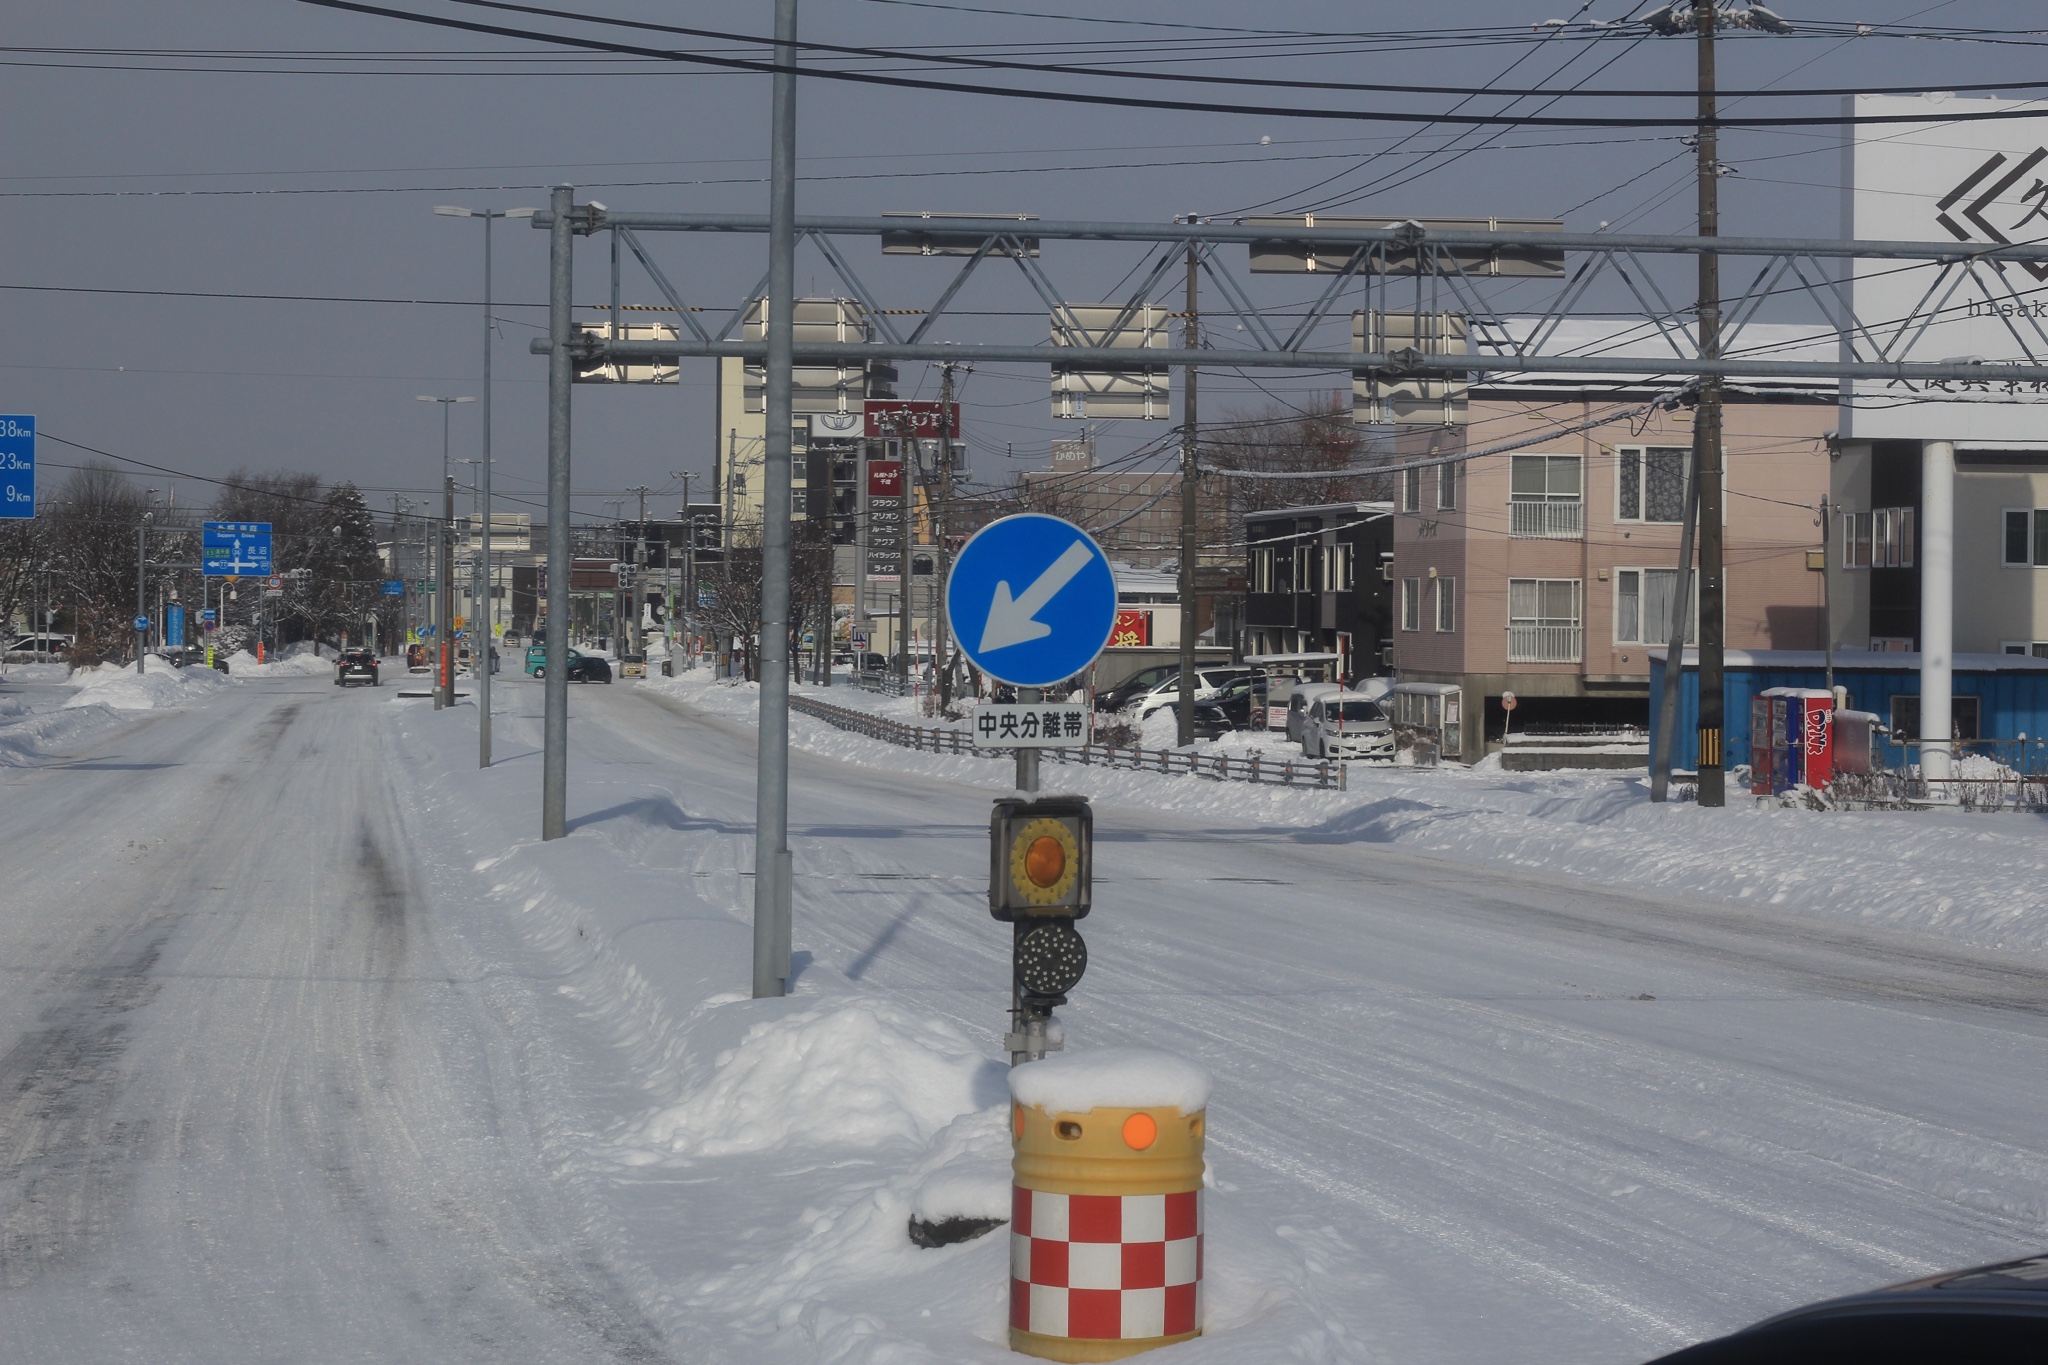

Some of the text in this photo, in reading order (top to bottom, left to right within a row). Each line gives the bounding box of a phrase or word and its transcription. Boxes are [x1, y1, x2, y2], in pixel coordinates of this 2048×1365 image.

[1055, 451, 1086, 461] かめや
[872, 525, 899, 533] ルーミー
[874, 564, 895, 572] ライズ
[978, 711, 1082, 739] 中央分離帯
[1806, 709, 1827, 755] DRINK
